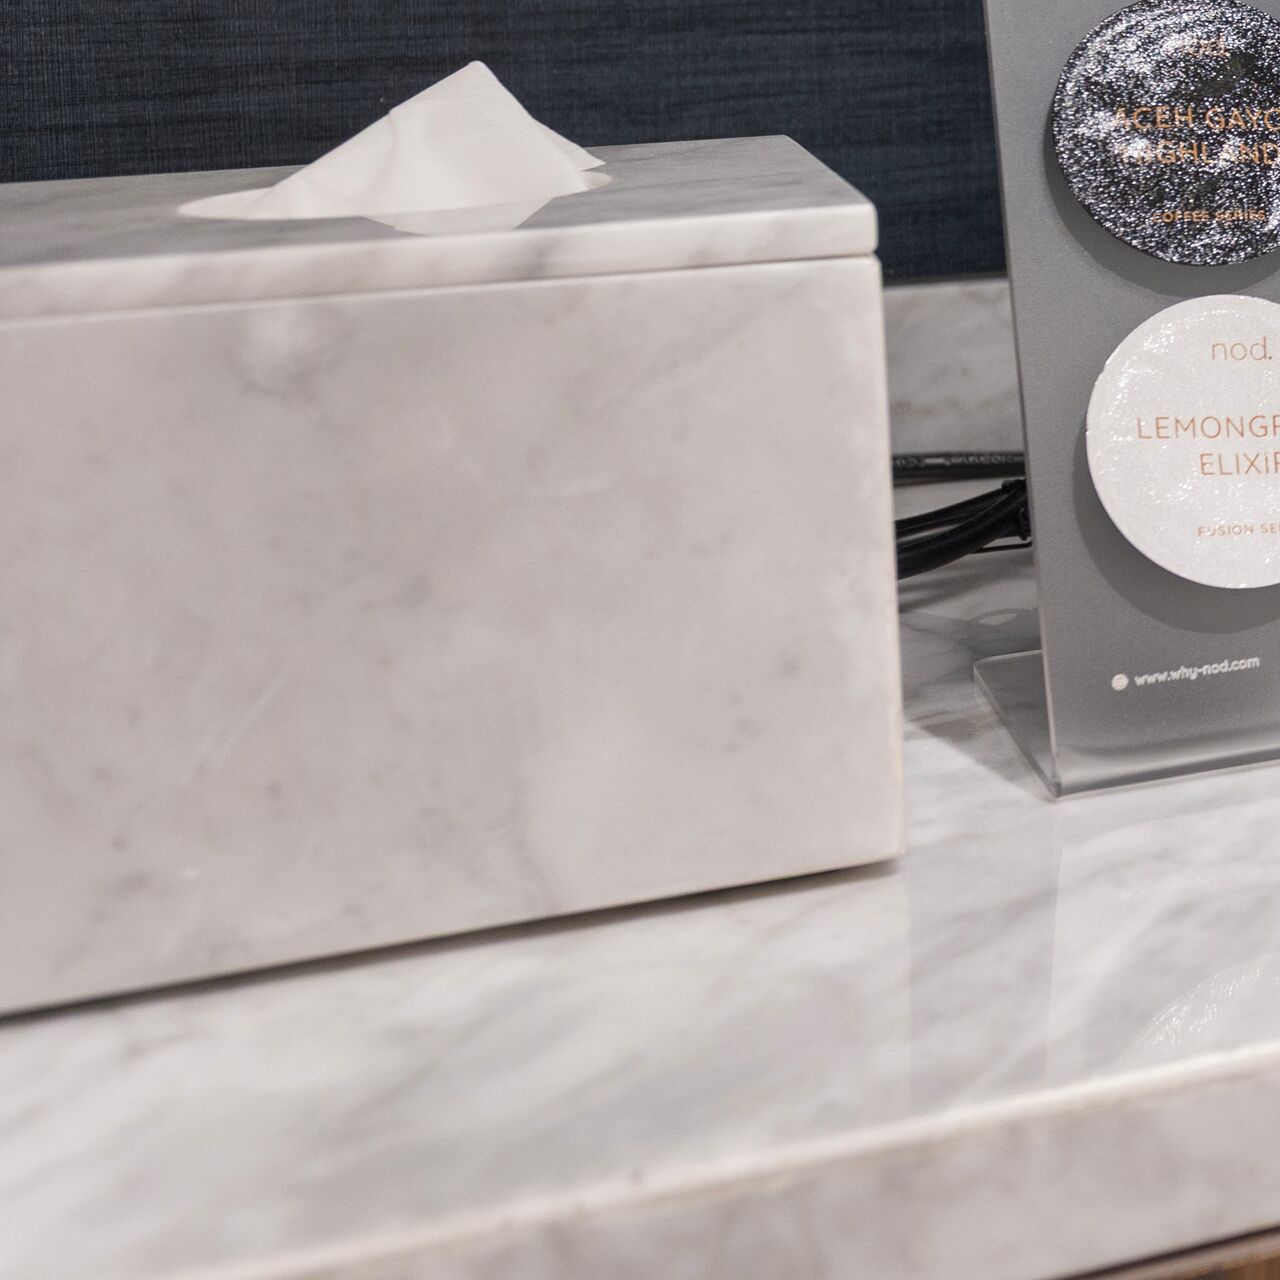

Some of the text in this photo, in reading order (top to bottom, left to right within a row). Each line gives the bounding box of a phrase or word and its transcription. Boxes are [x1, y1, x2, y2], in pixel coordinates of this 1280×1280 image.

[1114, 105, 1194, 129] ACEH
[1211, 336, 1272, 361] nod.
[1197, 524, 1254, 537] FUSION
[1134, 657, 1260, 686] www.why-nod.com
